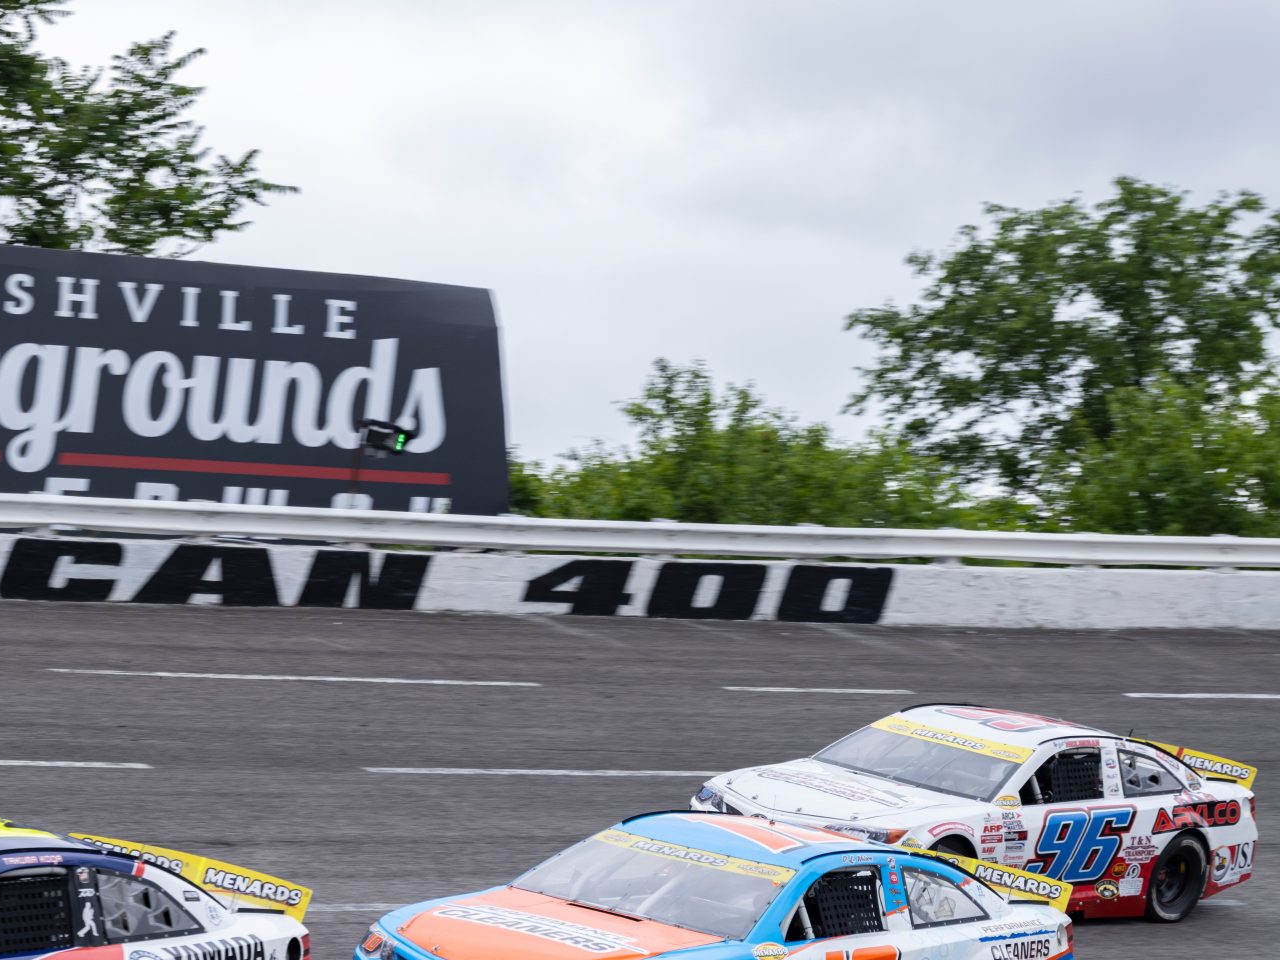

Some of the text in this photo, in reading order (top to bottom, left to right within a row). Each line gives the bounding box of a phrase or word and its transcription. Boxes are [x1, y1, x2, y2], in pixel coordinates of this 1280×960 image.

[523, 558, 895, 625] 400
[912, 729, 985, 750] MENARDS
[1182, 754, 1251, 780] MENARDS
[983, 824, 1003, 833] ARP
[630, 839, 729, 867] MENARDS
[1024, 805, 1137, 884] 96
[203, 867, 302, 906] MENARDS
[974, 864, 1062, 899] MENARDS
[438, 909, 617, 952] CLEANERS
[981, 918, 1045, 934] PERFORMANCE
[754, 948, 789, 957] MENARDS
